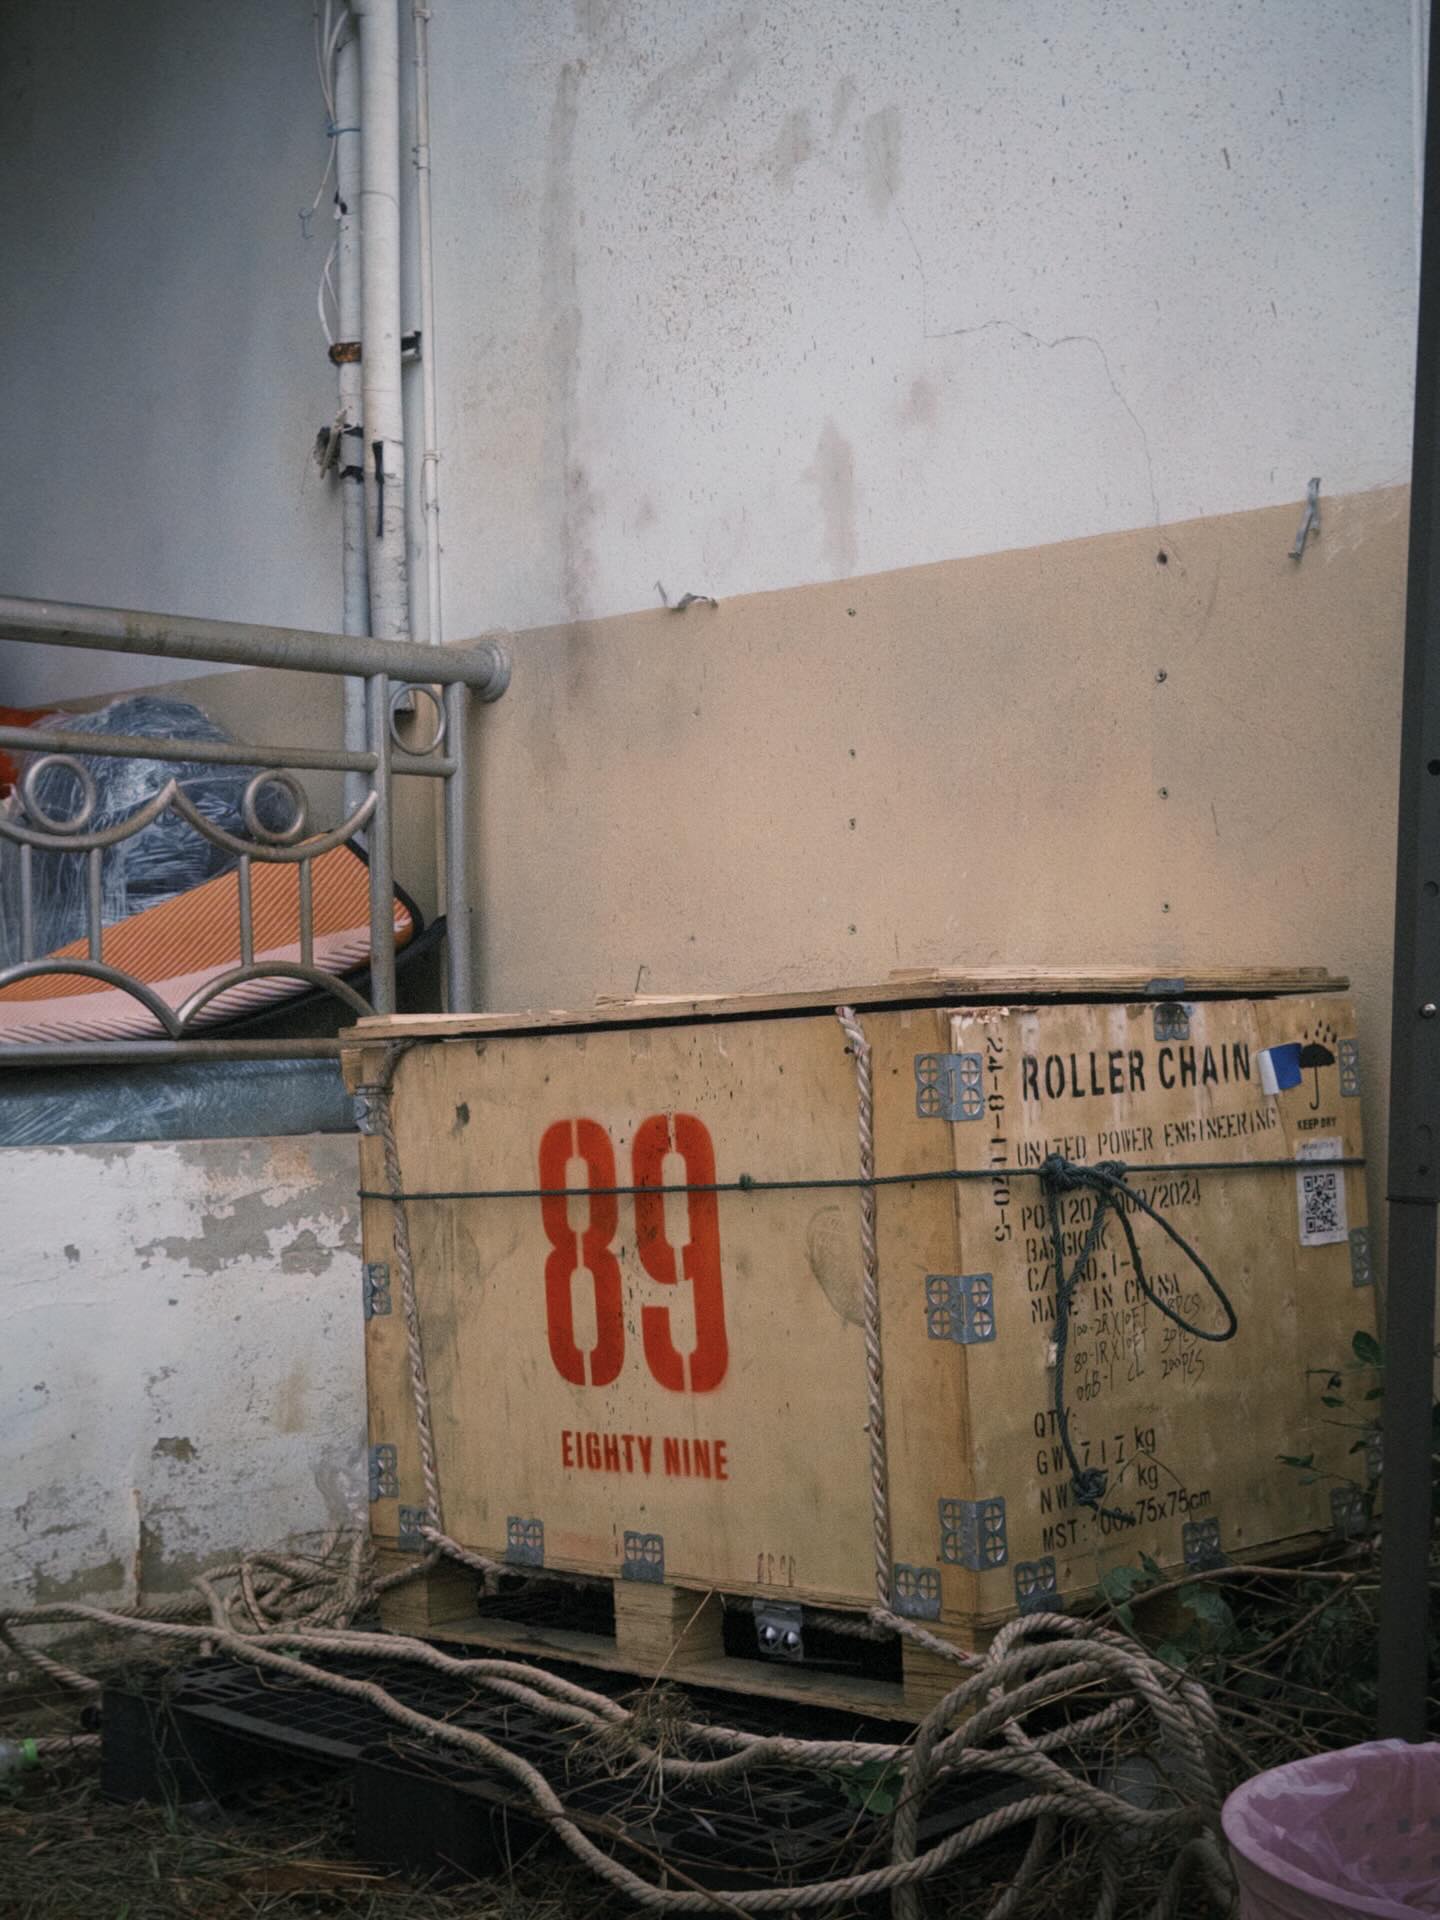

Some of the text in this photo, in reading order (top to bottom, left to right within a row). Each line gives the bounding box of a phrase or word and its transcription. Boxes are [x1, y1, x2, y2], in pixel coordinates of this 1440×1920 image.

[1021, 1042, 1252, 1101] ROLLER CHAIN
[1017, 1107, 1276, 1168] UNITED POWER ENGINEERING
[1297, 1116, 1337, 1130] KEEP DRY
[538, 1112, 729, 1393] 89
[1031, 1290, 1078, 1324] MAE
[1094, 1282, 1114, 1311] IN
[561, 1430, 729, 1481] EIGHTY NINE
[1135, 1426, 1156, 1453] kg
[1138, 1464, 1158, 1490] kg
[1043, 1518, 1087, 1552] MST:
